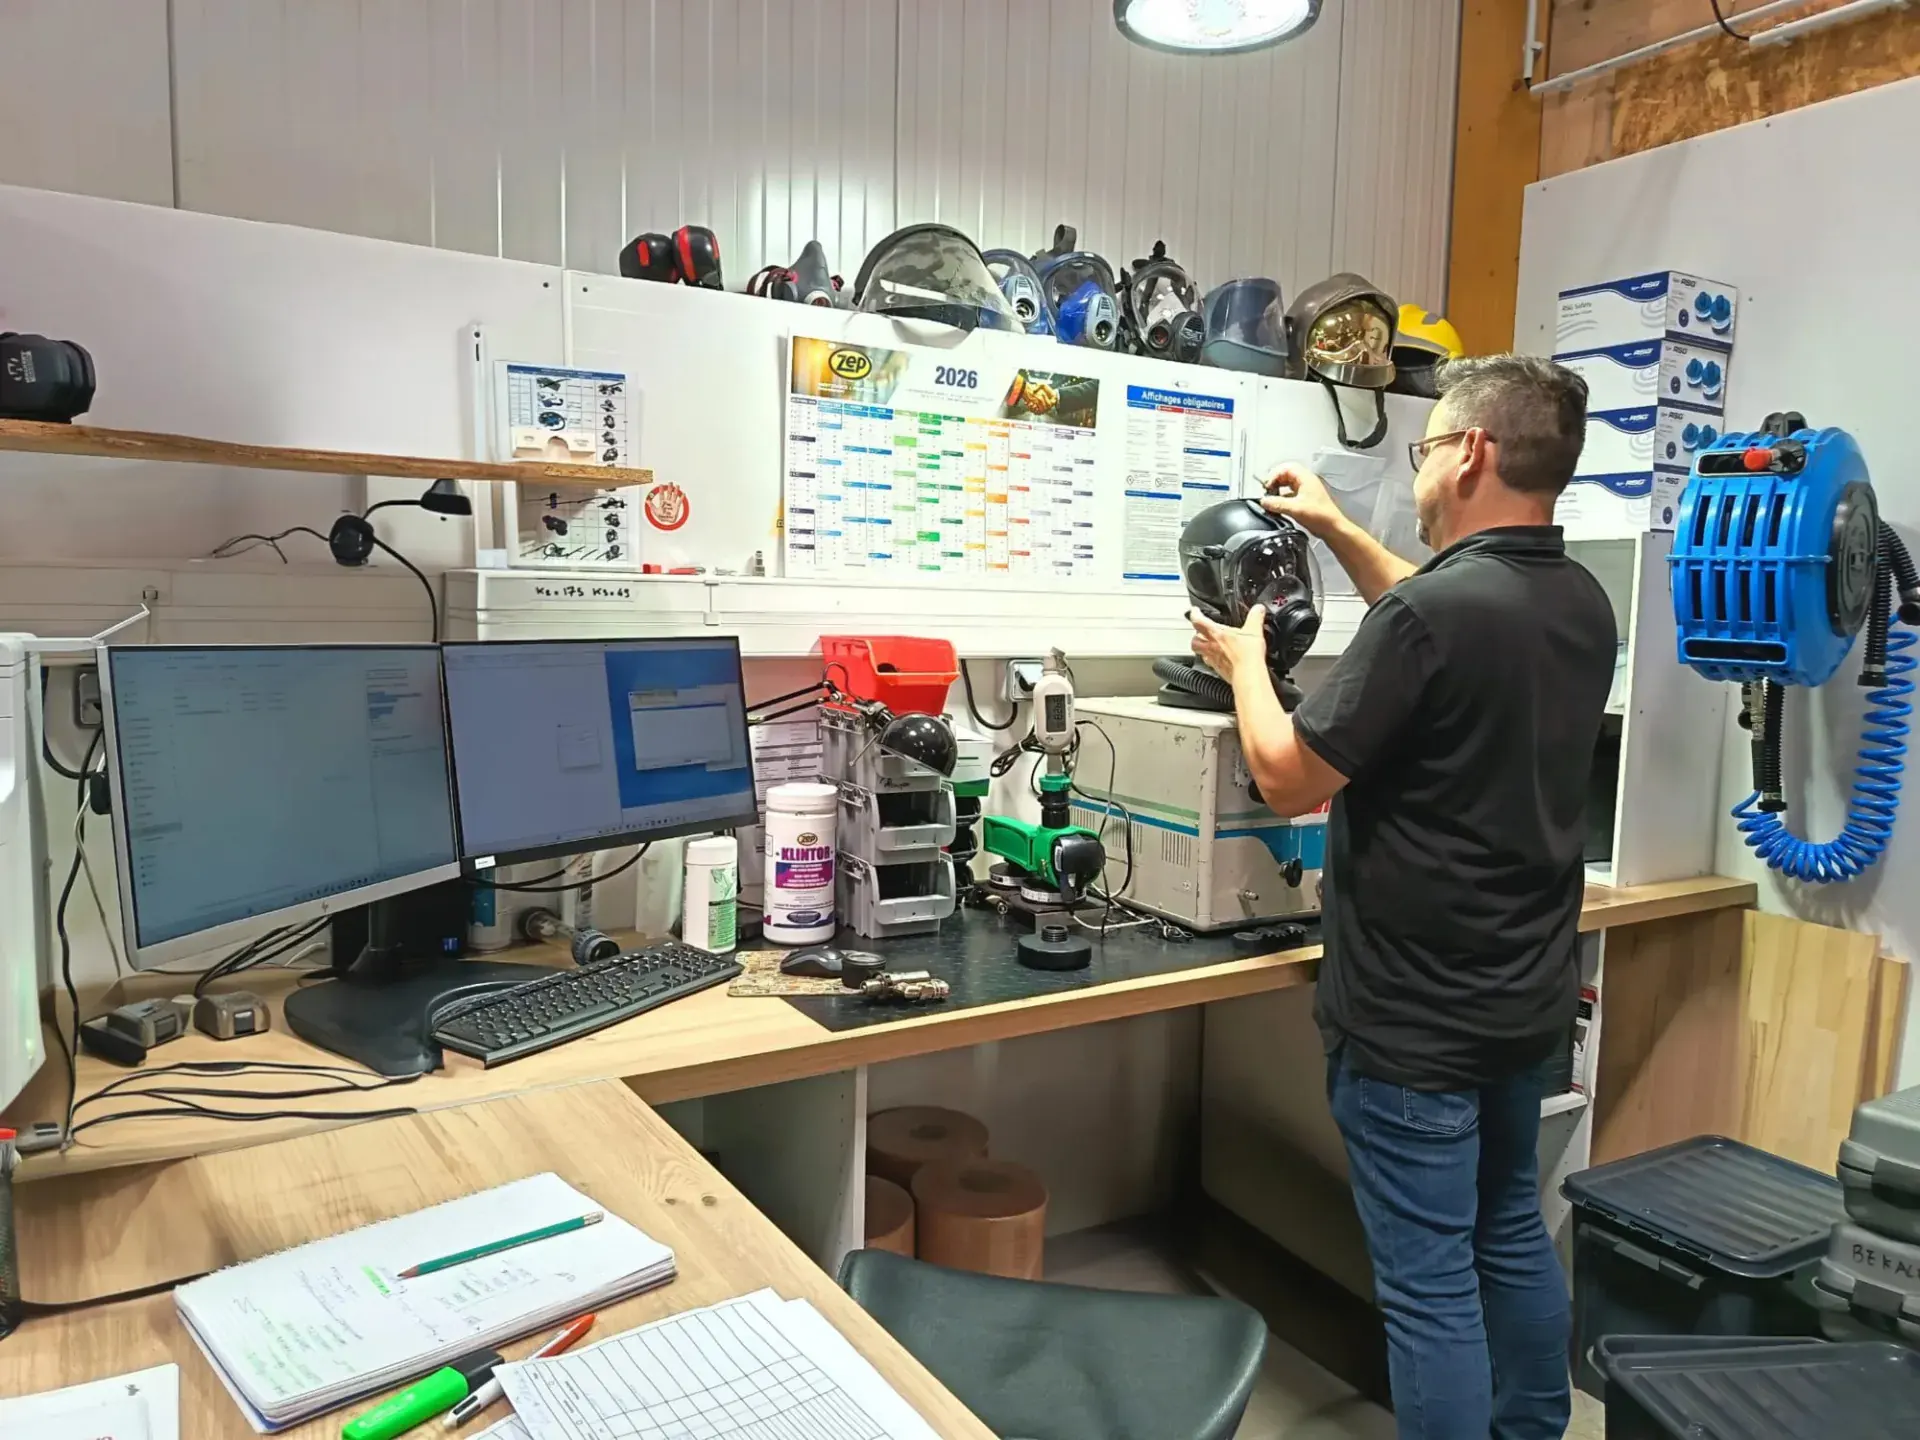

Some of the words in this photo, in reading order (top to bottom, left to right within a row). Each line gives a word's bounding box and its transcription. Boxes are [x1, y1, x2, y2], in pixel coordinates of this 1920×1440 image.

[935, 366, 978, 389] 2026
[1141, 391, 1182, 405] Affichages
[1183, 396, 1225, 410] obligatoires
[781, 846, 830, 861] KLINTOR
